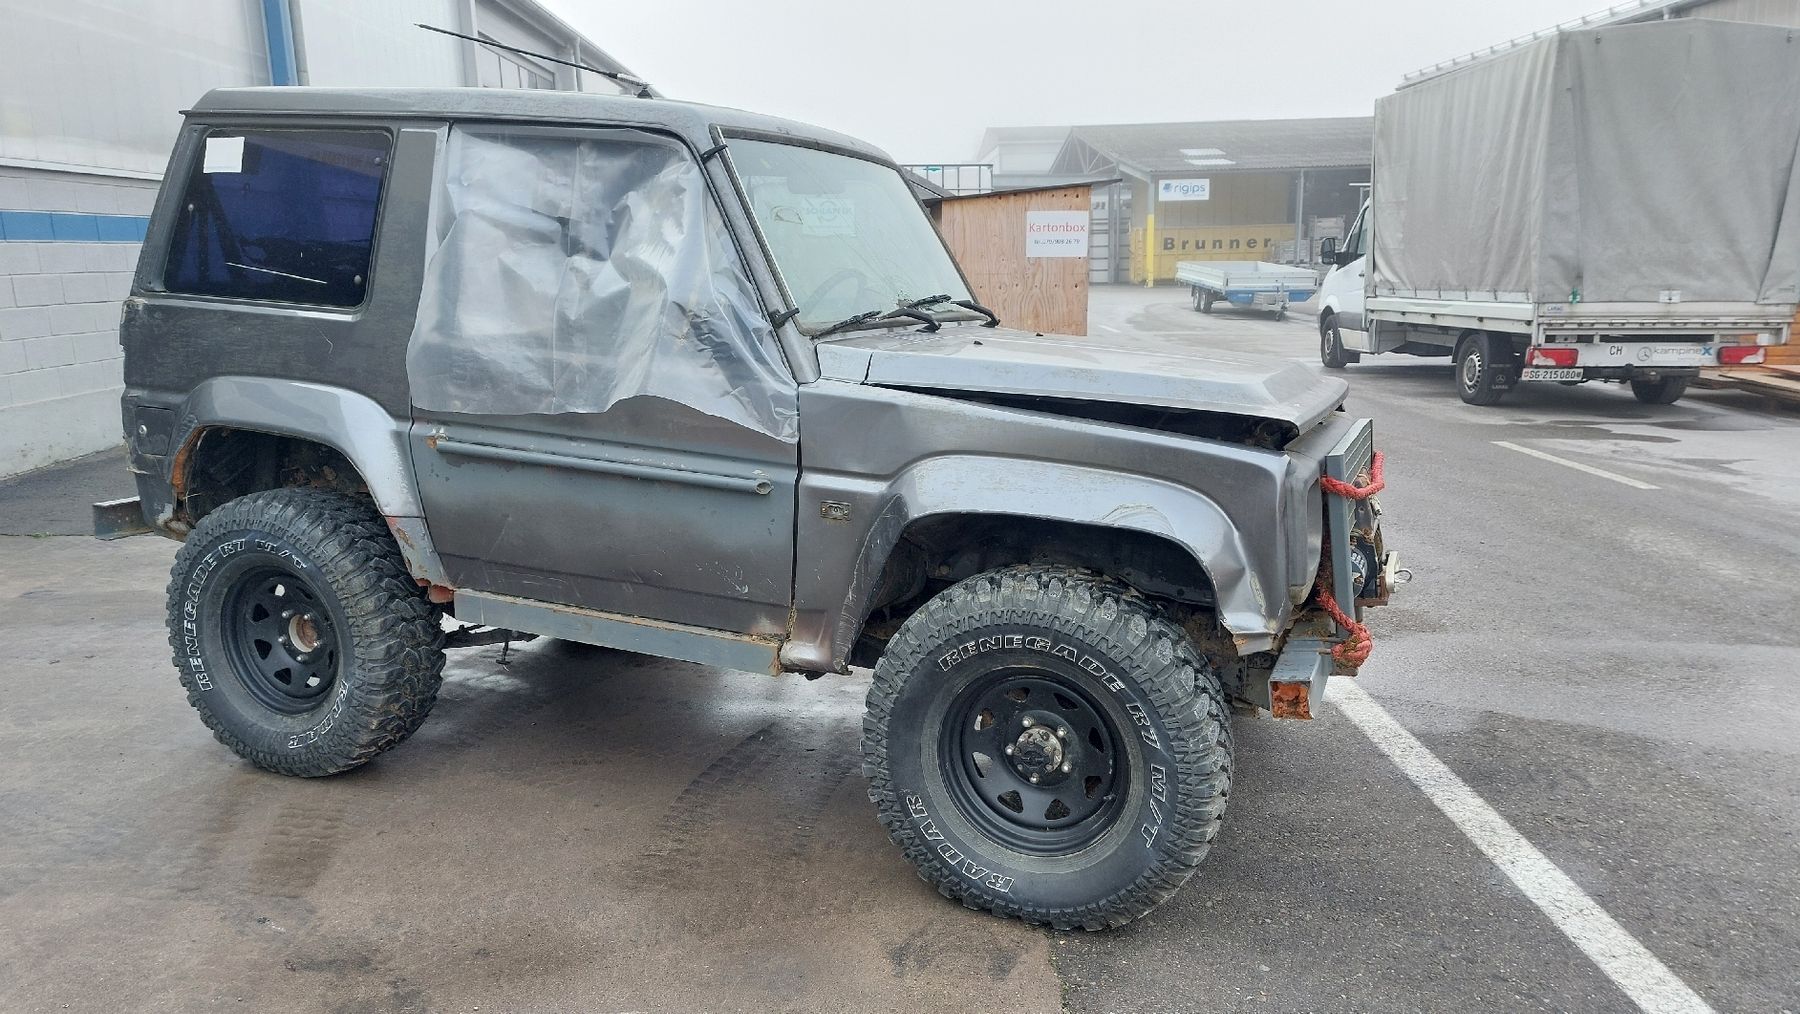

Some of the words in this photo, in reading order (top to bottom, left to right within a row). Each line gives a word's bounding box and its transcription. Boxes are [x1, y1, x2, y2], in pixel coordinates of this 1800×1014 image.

[1174, 182, 1206, 194] rigips
[1029, 222, 1086, 233] Kartonbox
[1163, 237, 1272, 250] Brunner
[1609, 345, 1623, 356] CH
[184, 553, 217, 691] RENEGADE
[937, 634, 1126, 693] RENEGADE
[1126, 702, 1162, 750] R7
[1141, 764, 1167, 849] M/T
[906, 794, 1016, 893] RADAR
